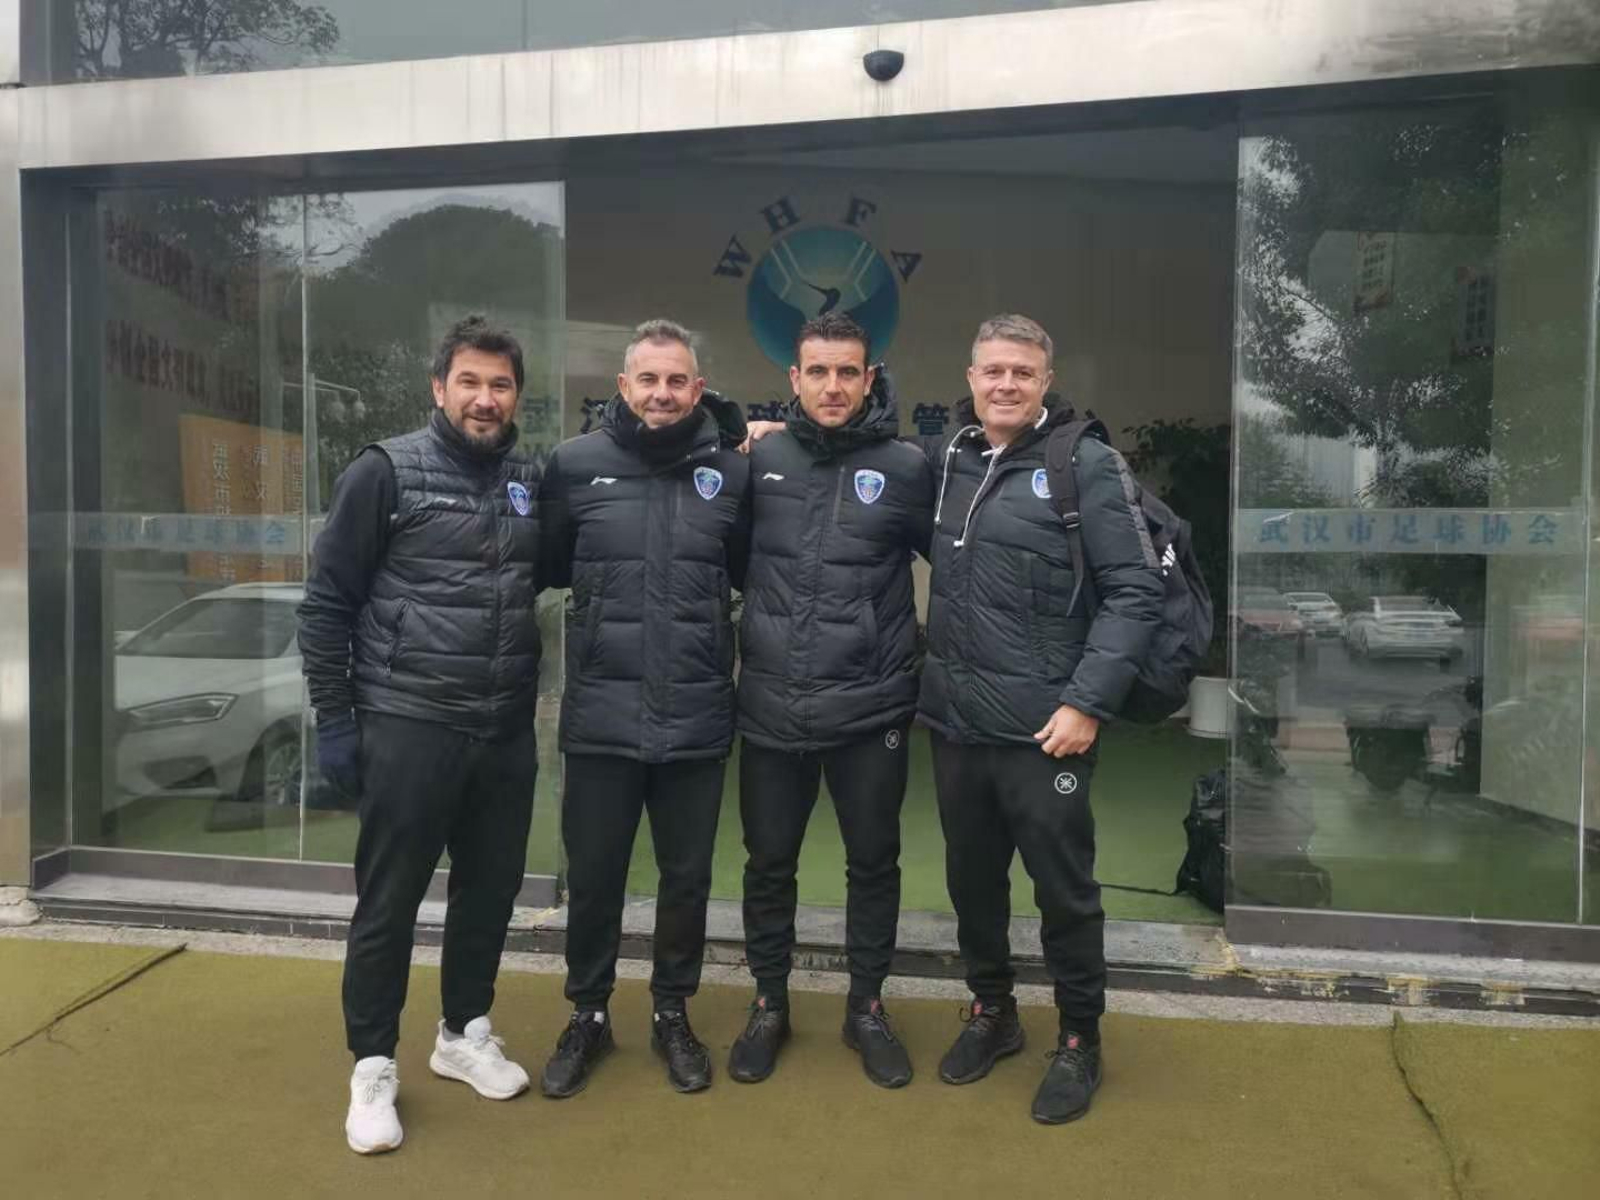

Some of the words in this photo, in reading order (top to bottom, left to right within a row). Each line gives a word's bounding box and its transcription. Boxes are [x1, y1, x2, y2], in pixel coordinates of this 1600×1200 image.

[1259, 514, 1559, 544] 武汉市足球协会
